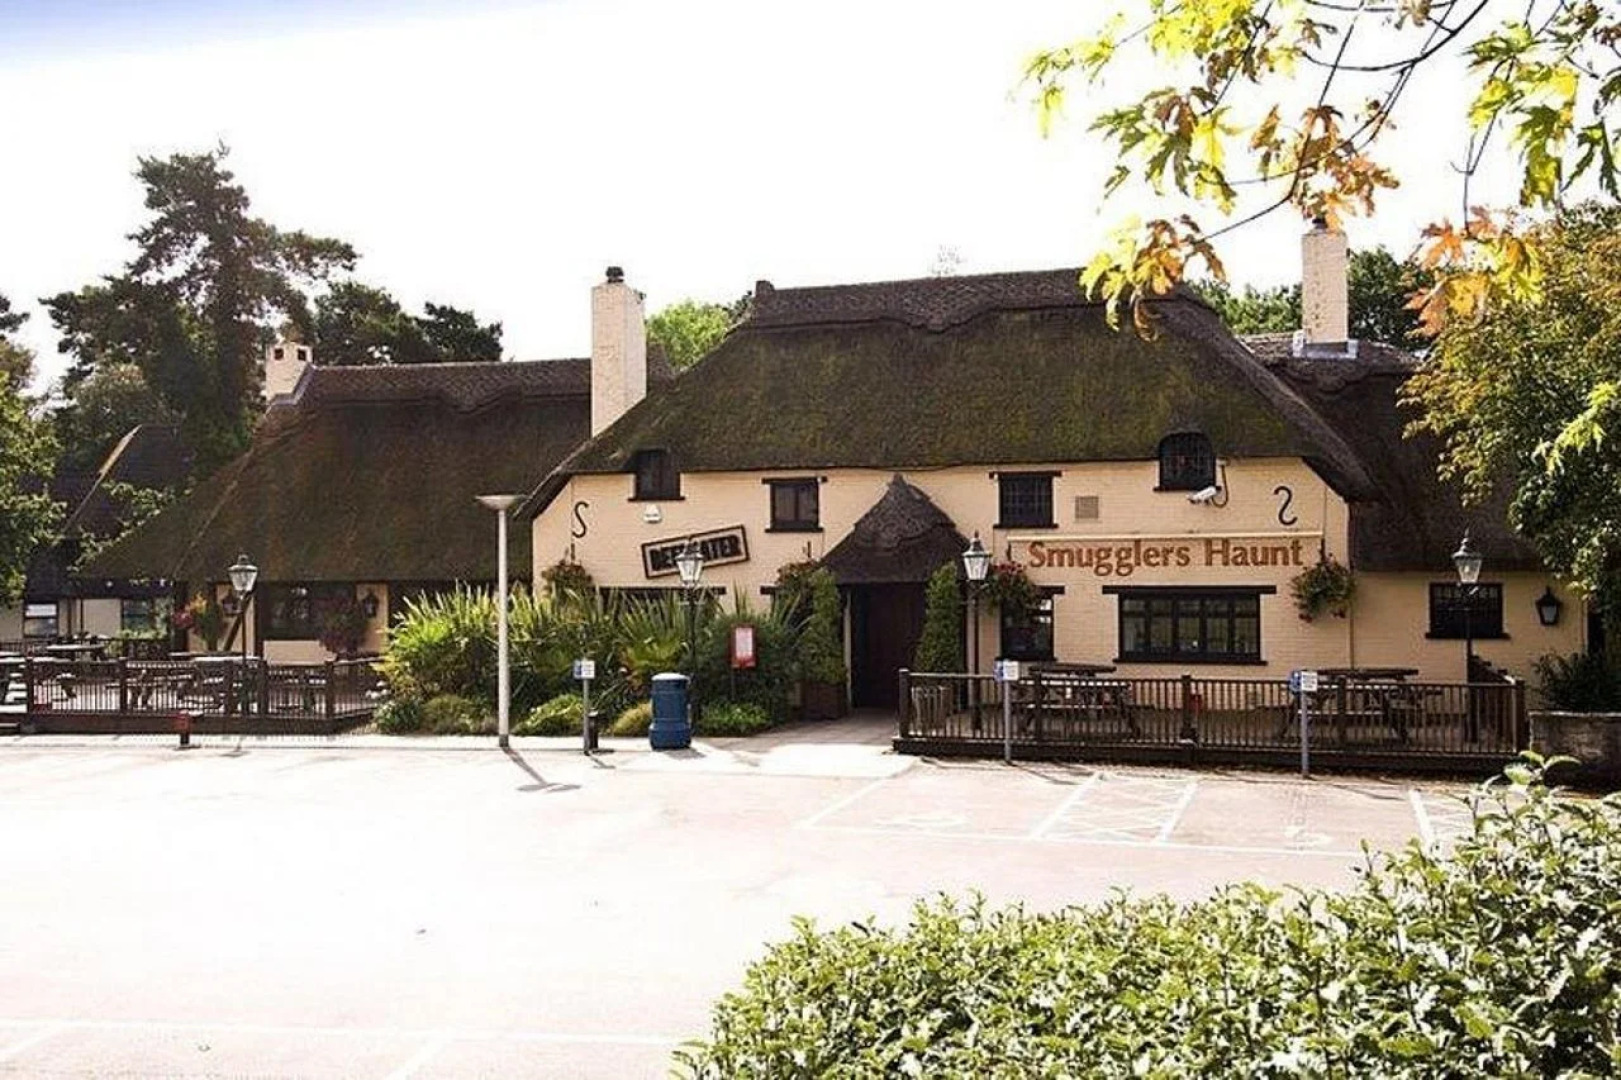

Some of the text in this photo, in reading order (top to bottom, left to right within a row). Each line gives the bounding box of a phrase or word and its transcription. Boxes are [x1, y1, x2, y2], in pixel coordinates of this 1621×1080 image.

[650, 534, 743, 571] BEEATER
[1028, 538, 1303, 576] Smugglers Haunt
